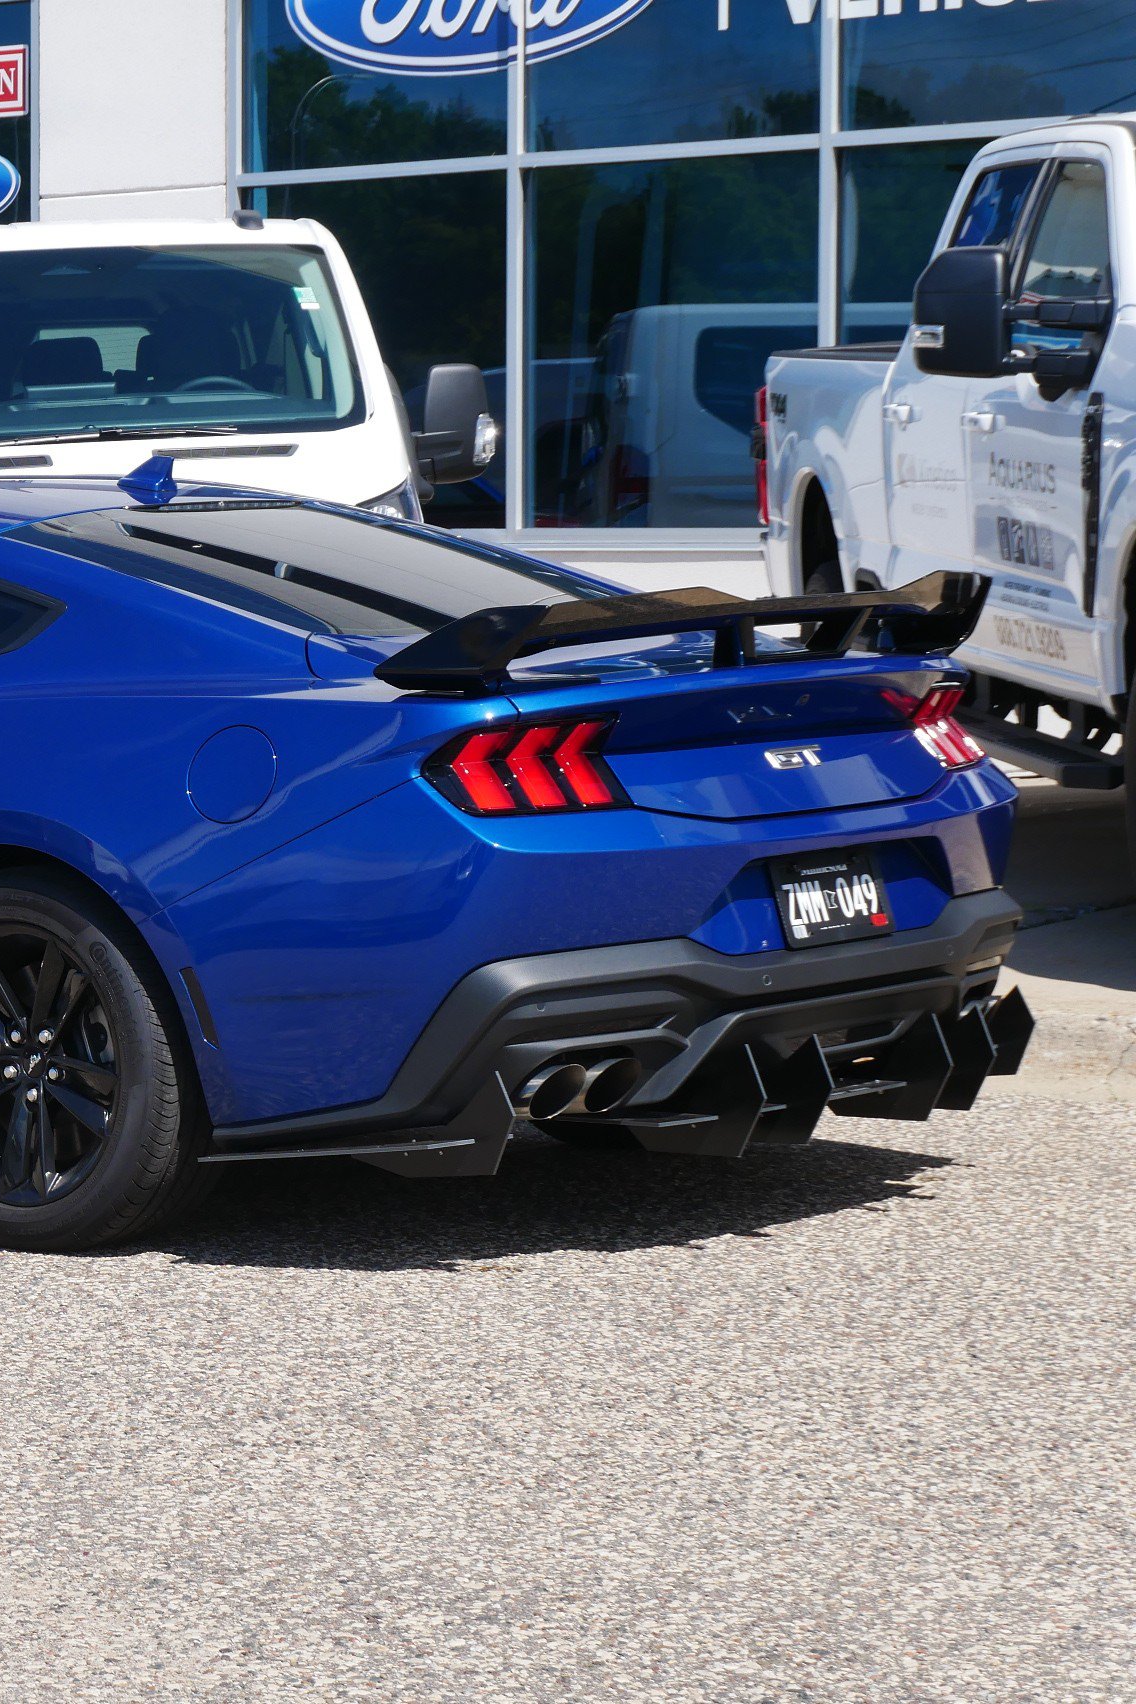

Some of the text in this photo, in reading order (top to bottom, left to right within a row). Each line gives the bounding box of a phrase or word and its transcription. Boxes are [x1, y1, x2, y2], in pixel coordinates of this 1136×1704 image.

[764, 744, 822, 769] GT
[781, 873, 879, 926] ZMM 049
